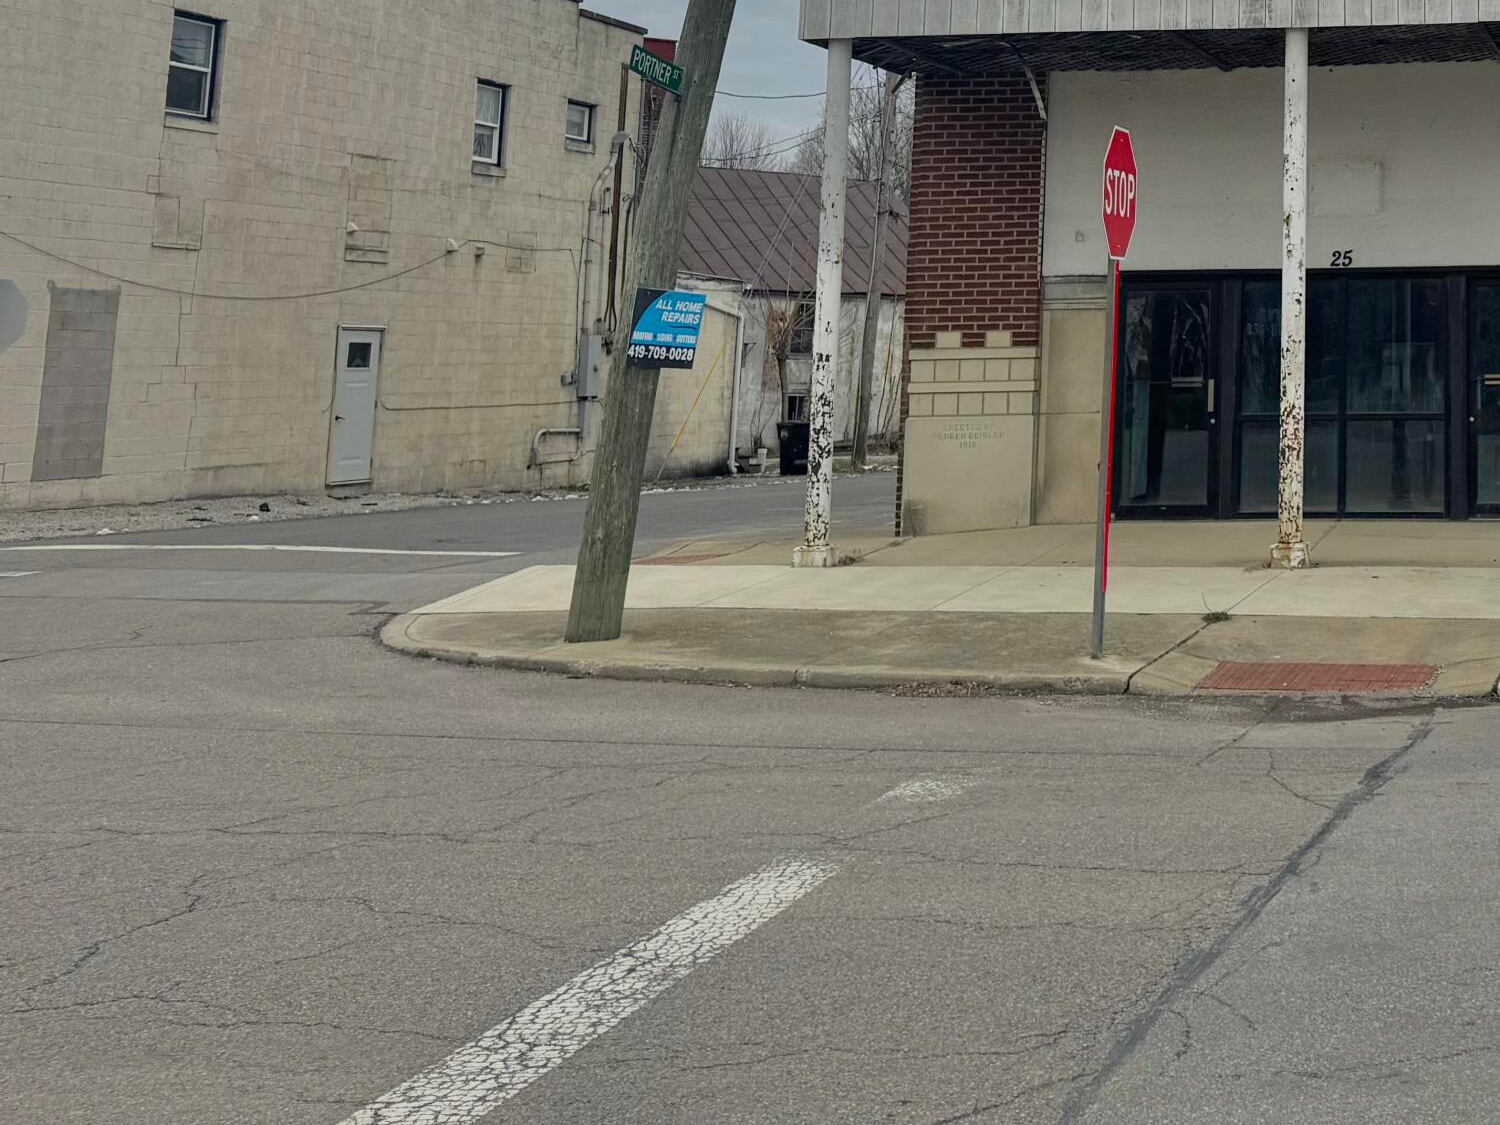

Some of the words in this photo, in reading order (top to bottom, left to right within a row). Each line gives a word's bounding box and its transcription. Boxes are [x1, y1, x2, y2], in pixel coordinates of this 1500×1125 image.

[632, 49, 672, 85] PORTNER
[673, 69, 680, 80] ST
[1105, 167, 1136, 218] STOP
[1330, 249, 1354, 267] 25
[656, 299, 672, 310] ALL
[674, 301, 704, 313] HOME
[661, 312, 701, 325] REPAIRS
[627, 345, 694, 361] 419-709-0028
